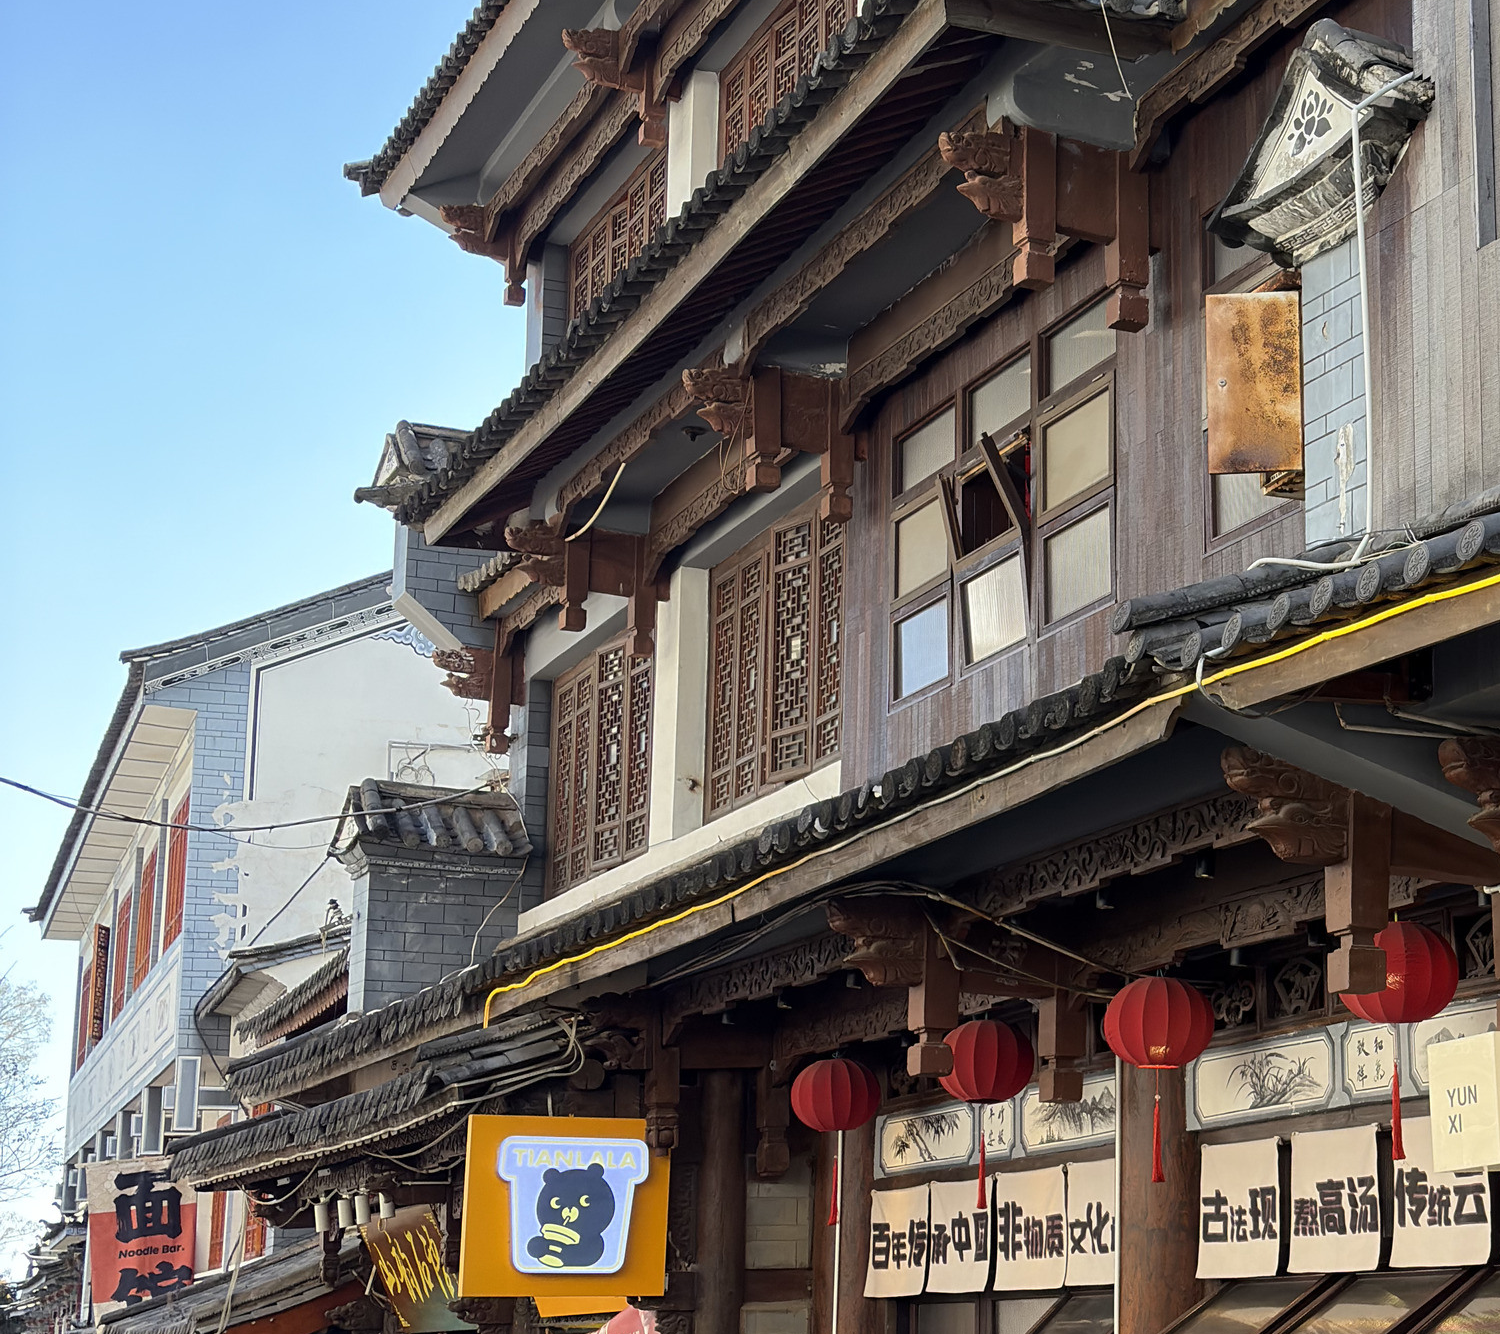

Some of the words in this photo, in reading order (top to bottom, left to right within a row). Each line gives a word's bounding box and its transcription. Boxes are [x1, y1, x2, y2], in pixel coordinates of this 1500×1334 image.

[1446, 1084, 1478, 1108] YUN
[1448, 1113, 1463, 1135] XI
[513, 1148, 637, 1169] TIANLALA
[113, 1168, 183, 1244] 面
[118, 1245, 159, 1259] Noodle
[161, 1243, 185, 1255] Bar.
